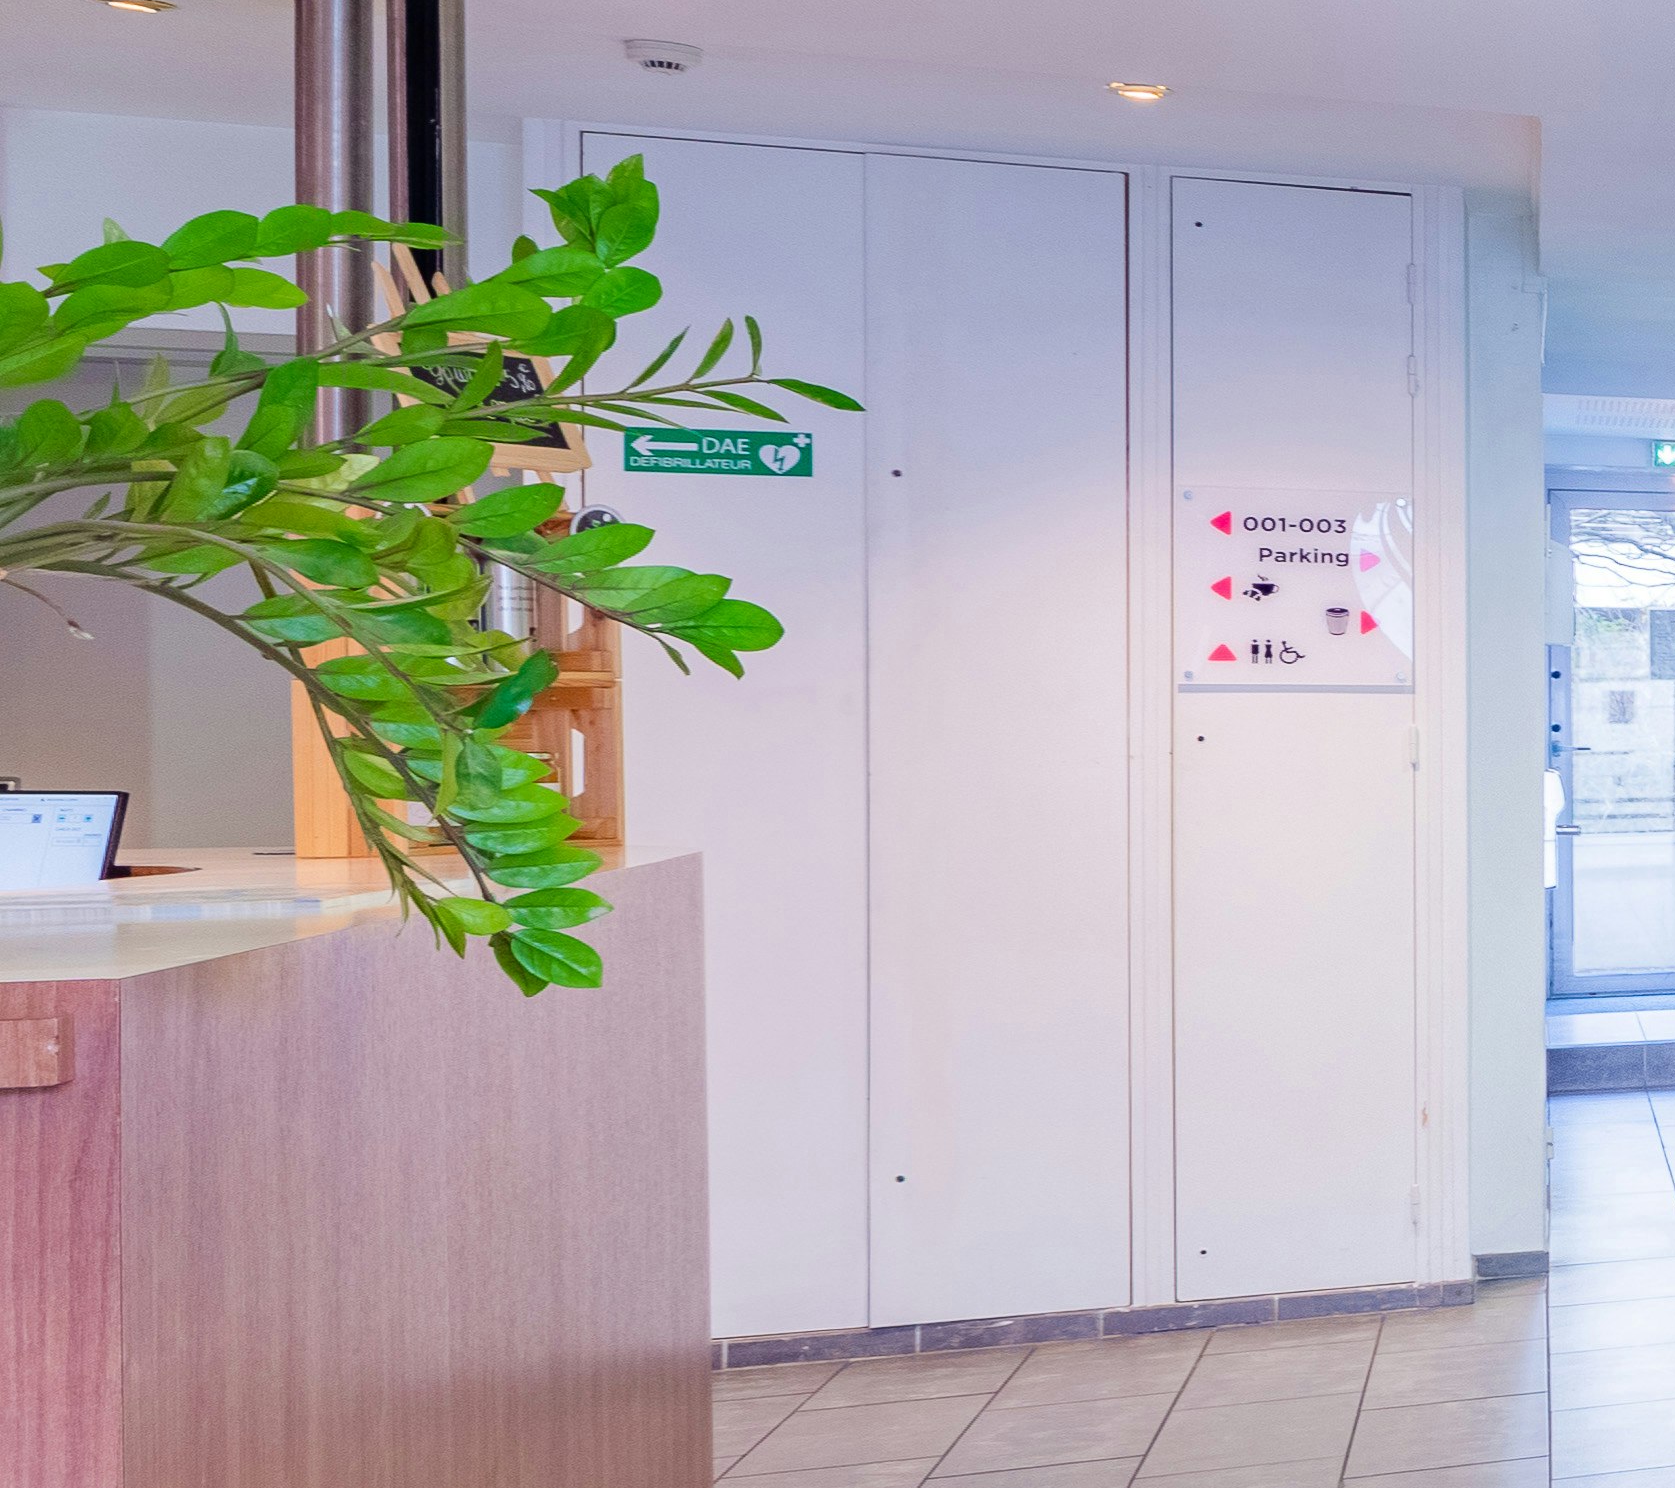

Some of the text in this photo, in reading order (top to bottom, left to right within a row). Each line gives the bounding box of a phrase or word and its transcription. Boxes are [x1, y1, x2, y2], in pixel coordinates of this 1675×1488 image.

[702, 436, 750, 455] DAE
[629, 456, 752, 470] DEFIBRILLATEUR
[1243, 516, 1347, 534] 001-003
[1258, 547, 1349, 567] Parking
